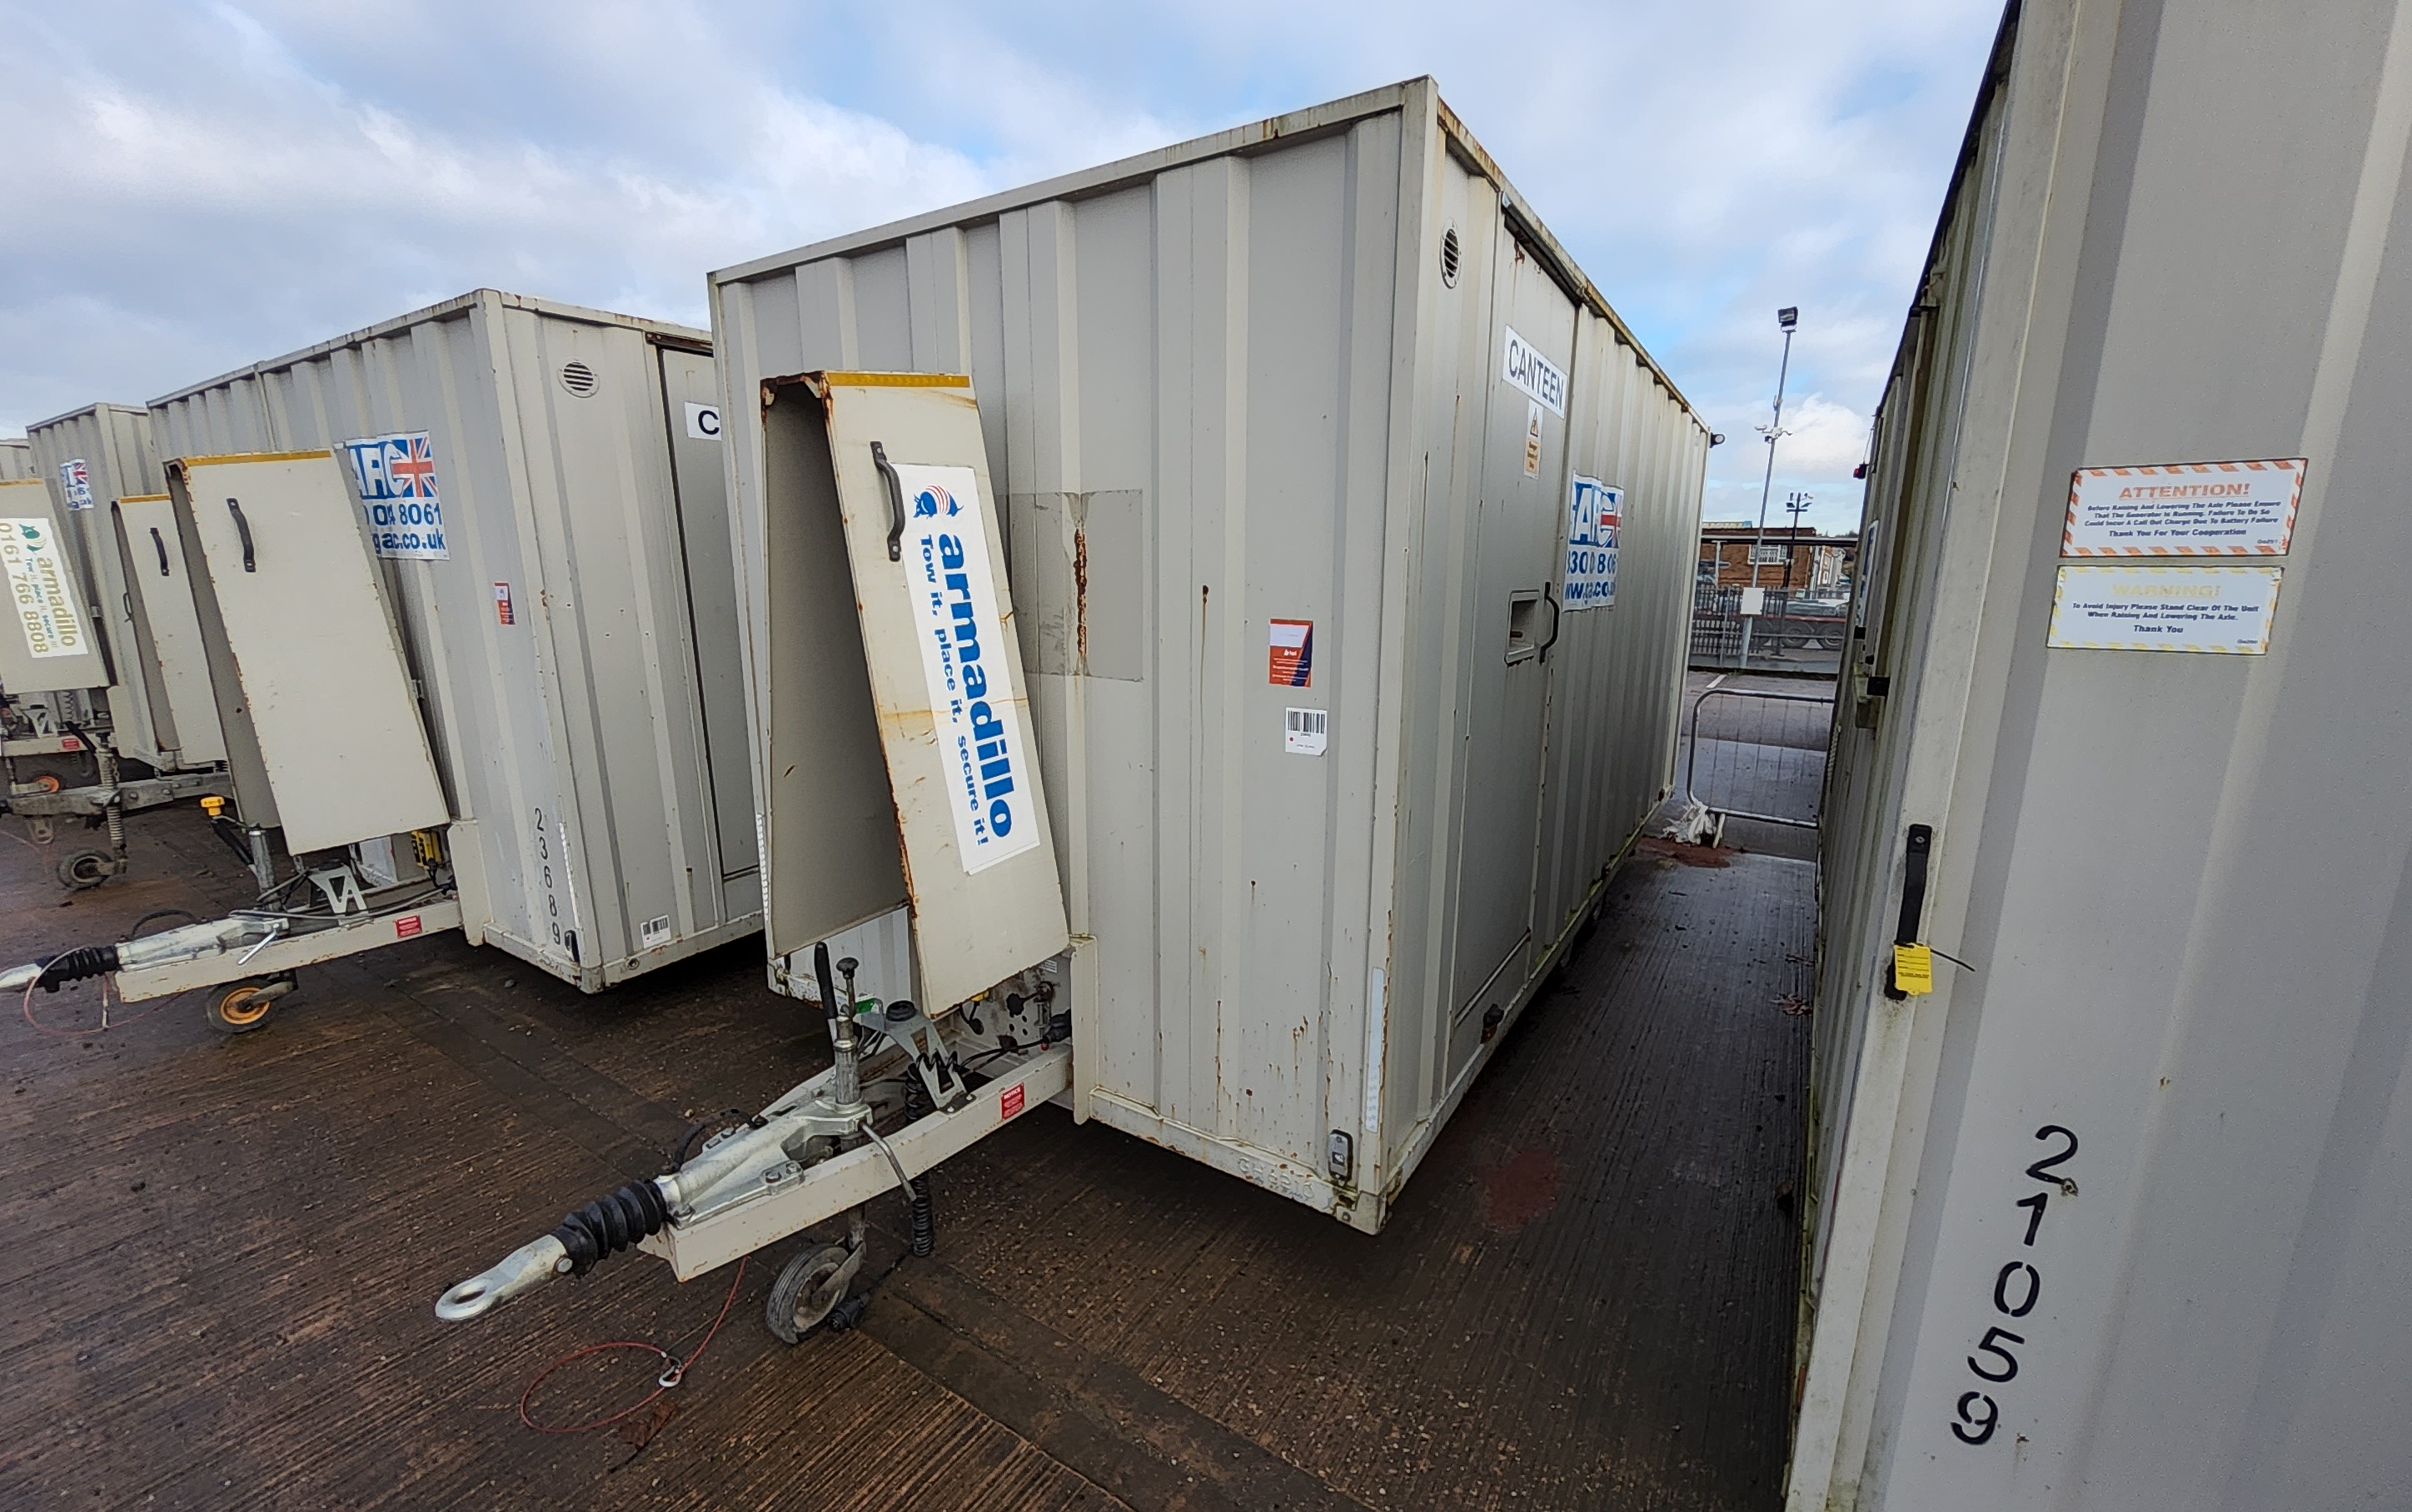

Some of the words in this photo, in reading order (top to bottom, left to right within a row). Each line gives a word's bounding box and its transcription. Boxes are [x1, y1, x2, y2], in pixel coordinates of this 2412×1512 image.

[1508, 339, 1564, 411] CANTEEN
[698, 410, 720, 435] C
[2118, 483, 2250, 499] ATTENTION!
[398, 502, 443, 526] 8061
[2192, 528, 2247, 537] Cooperation
[920, 534, 937, 584] Tow
[0, 522, 23, 565] 0161
[12, 572, 34, 605] 766
[23, 610, 49, 654] 8808
[36, 557, 78, 647] armadillo
[2111, 584, 2221, 596] WARNING!
[930, 591, 944, 617] it,
[2160, 613, 2199, 621] Lowering
[2133, 624, 2164, 633] Thank
[934, 629, 955, 691] place
[938, 534, 1015, 838] armadillo
[949, 699, 963, 724] it,
[957, 735, 979, 812] secure
[974, 817, 989, 846] it!
[535, 807, 561, 946] 23689
[1950, 1124, 2079, 1445] 21059
